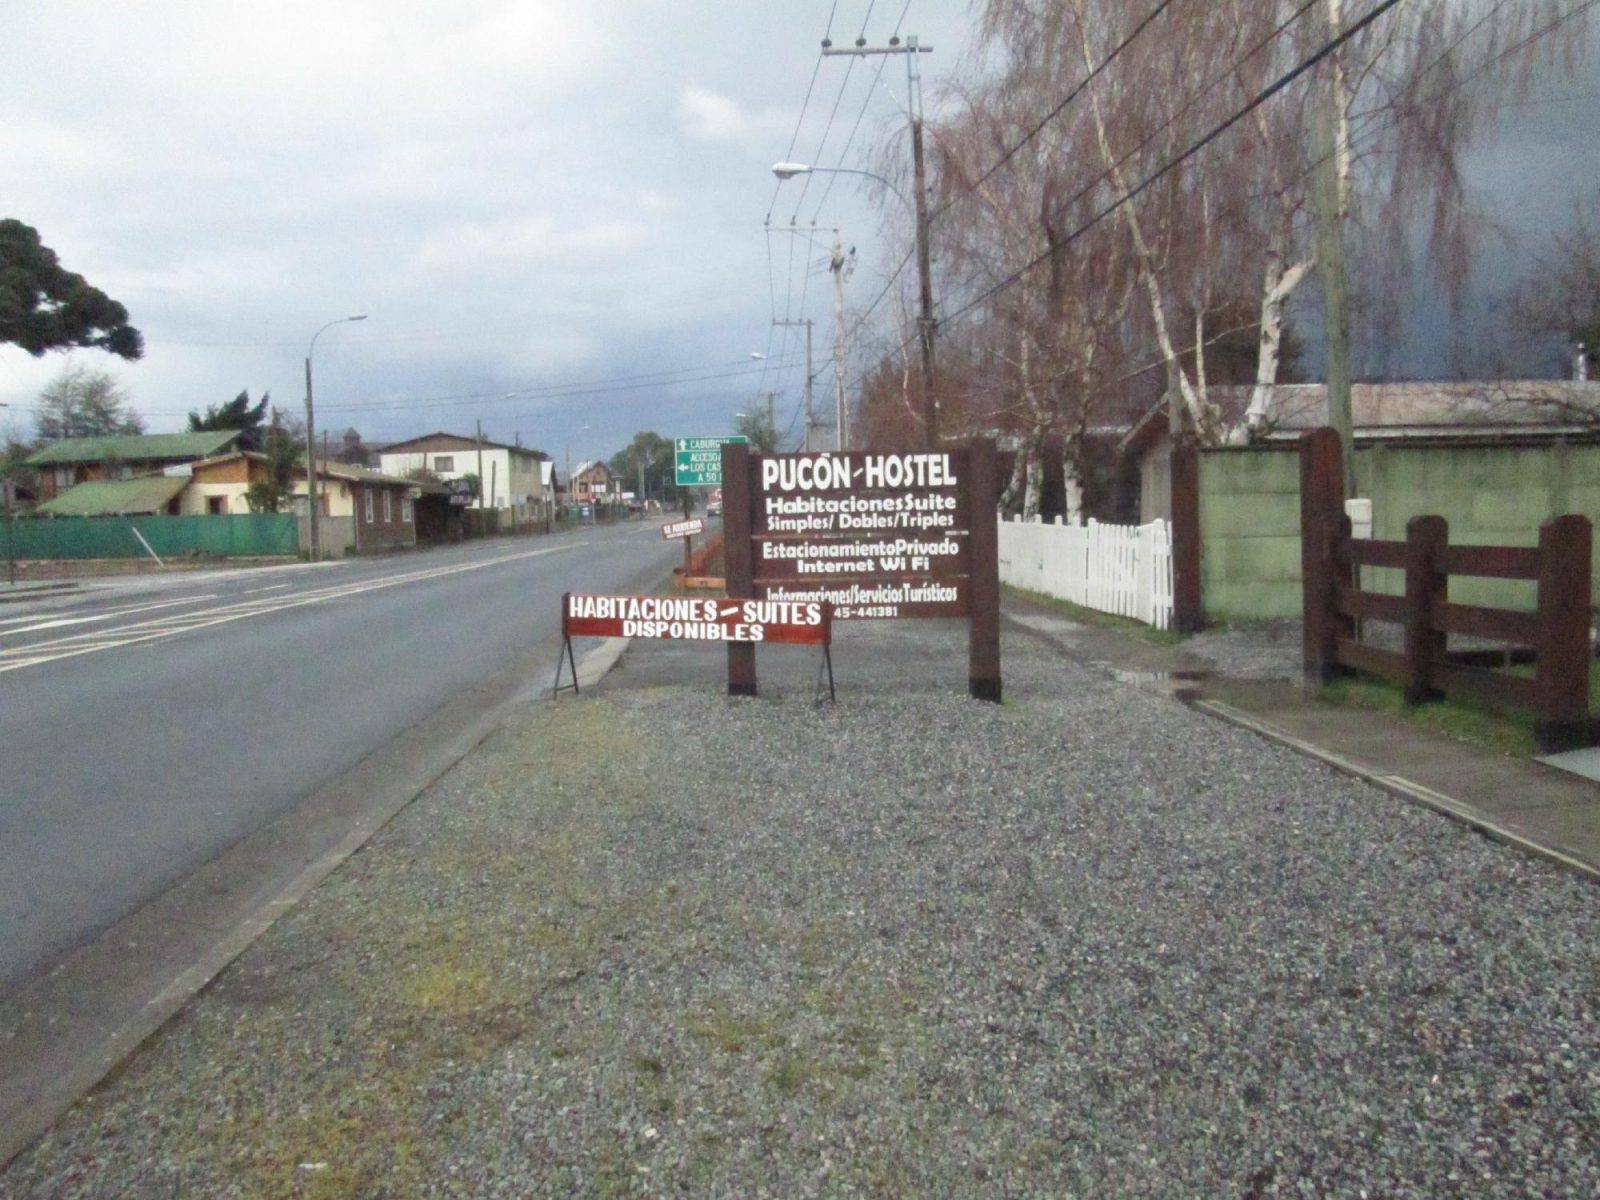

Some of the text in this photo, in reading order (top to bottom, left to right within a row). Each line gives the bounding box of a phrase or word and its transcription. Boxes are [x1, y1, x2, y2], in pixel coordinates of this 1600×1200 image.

[690, 462, 705, 472] LOS
[865, 454, 957, 488] HOSTEL
[797, 559, 875, 573] Internet
[569, 596, 718, 621] HABITACIONES
[743, 601, 821, 625] SUITES
[623, 620, 764, 642] DISPONIBLES
